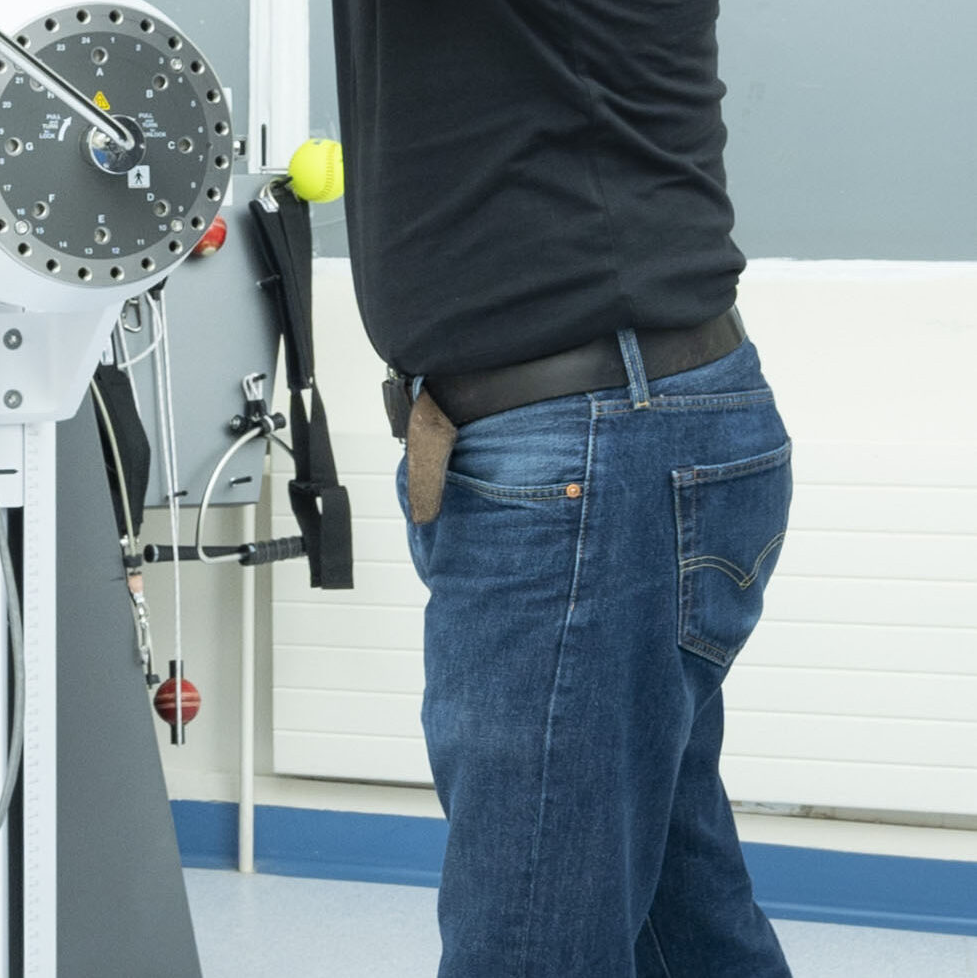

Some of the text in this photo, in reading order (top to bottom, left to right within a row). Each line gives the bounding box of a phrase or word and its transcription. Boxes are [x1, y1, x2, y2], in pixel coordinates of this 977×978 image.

[81, 36, 91, 44] 24
[158, 56, 164, 65] 3
[96, 67, 104, 76] A
[146, 89, 154, 98] B
[2, 101, 12, 109] 20
[25, 142, 34, 151] G
[168, 141, 176, 150] C
[3, 184, 12, 192] 17
[48, 194, 56, 203] F
[147, 193, 155, 202] D
[98, 214, 106, 223] E
[137, 238, 145, 246] 11
[84, 247, 93, 255] 13
[111, 246, 120, 254] 12
